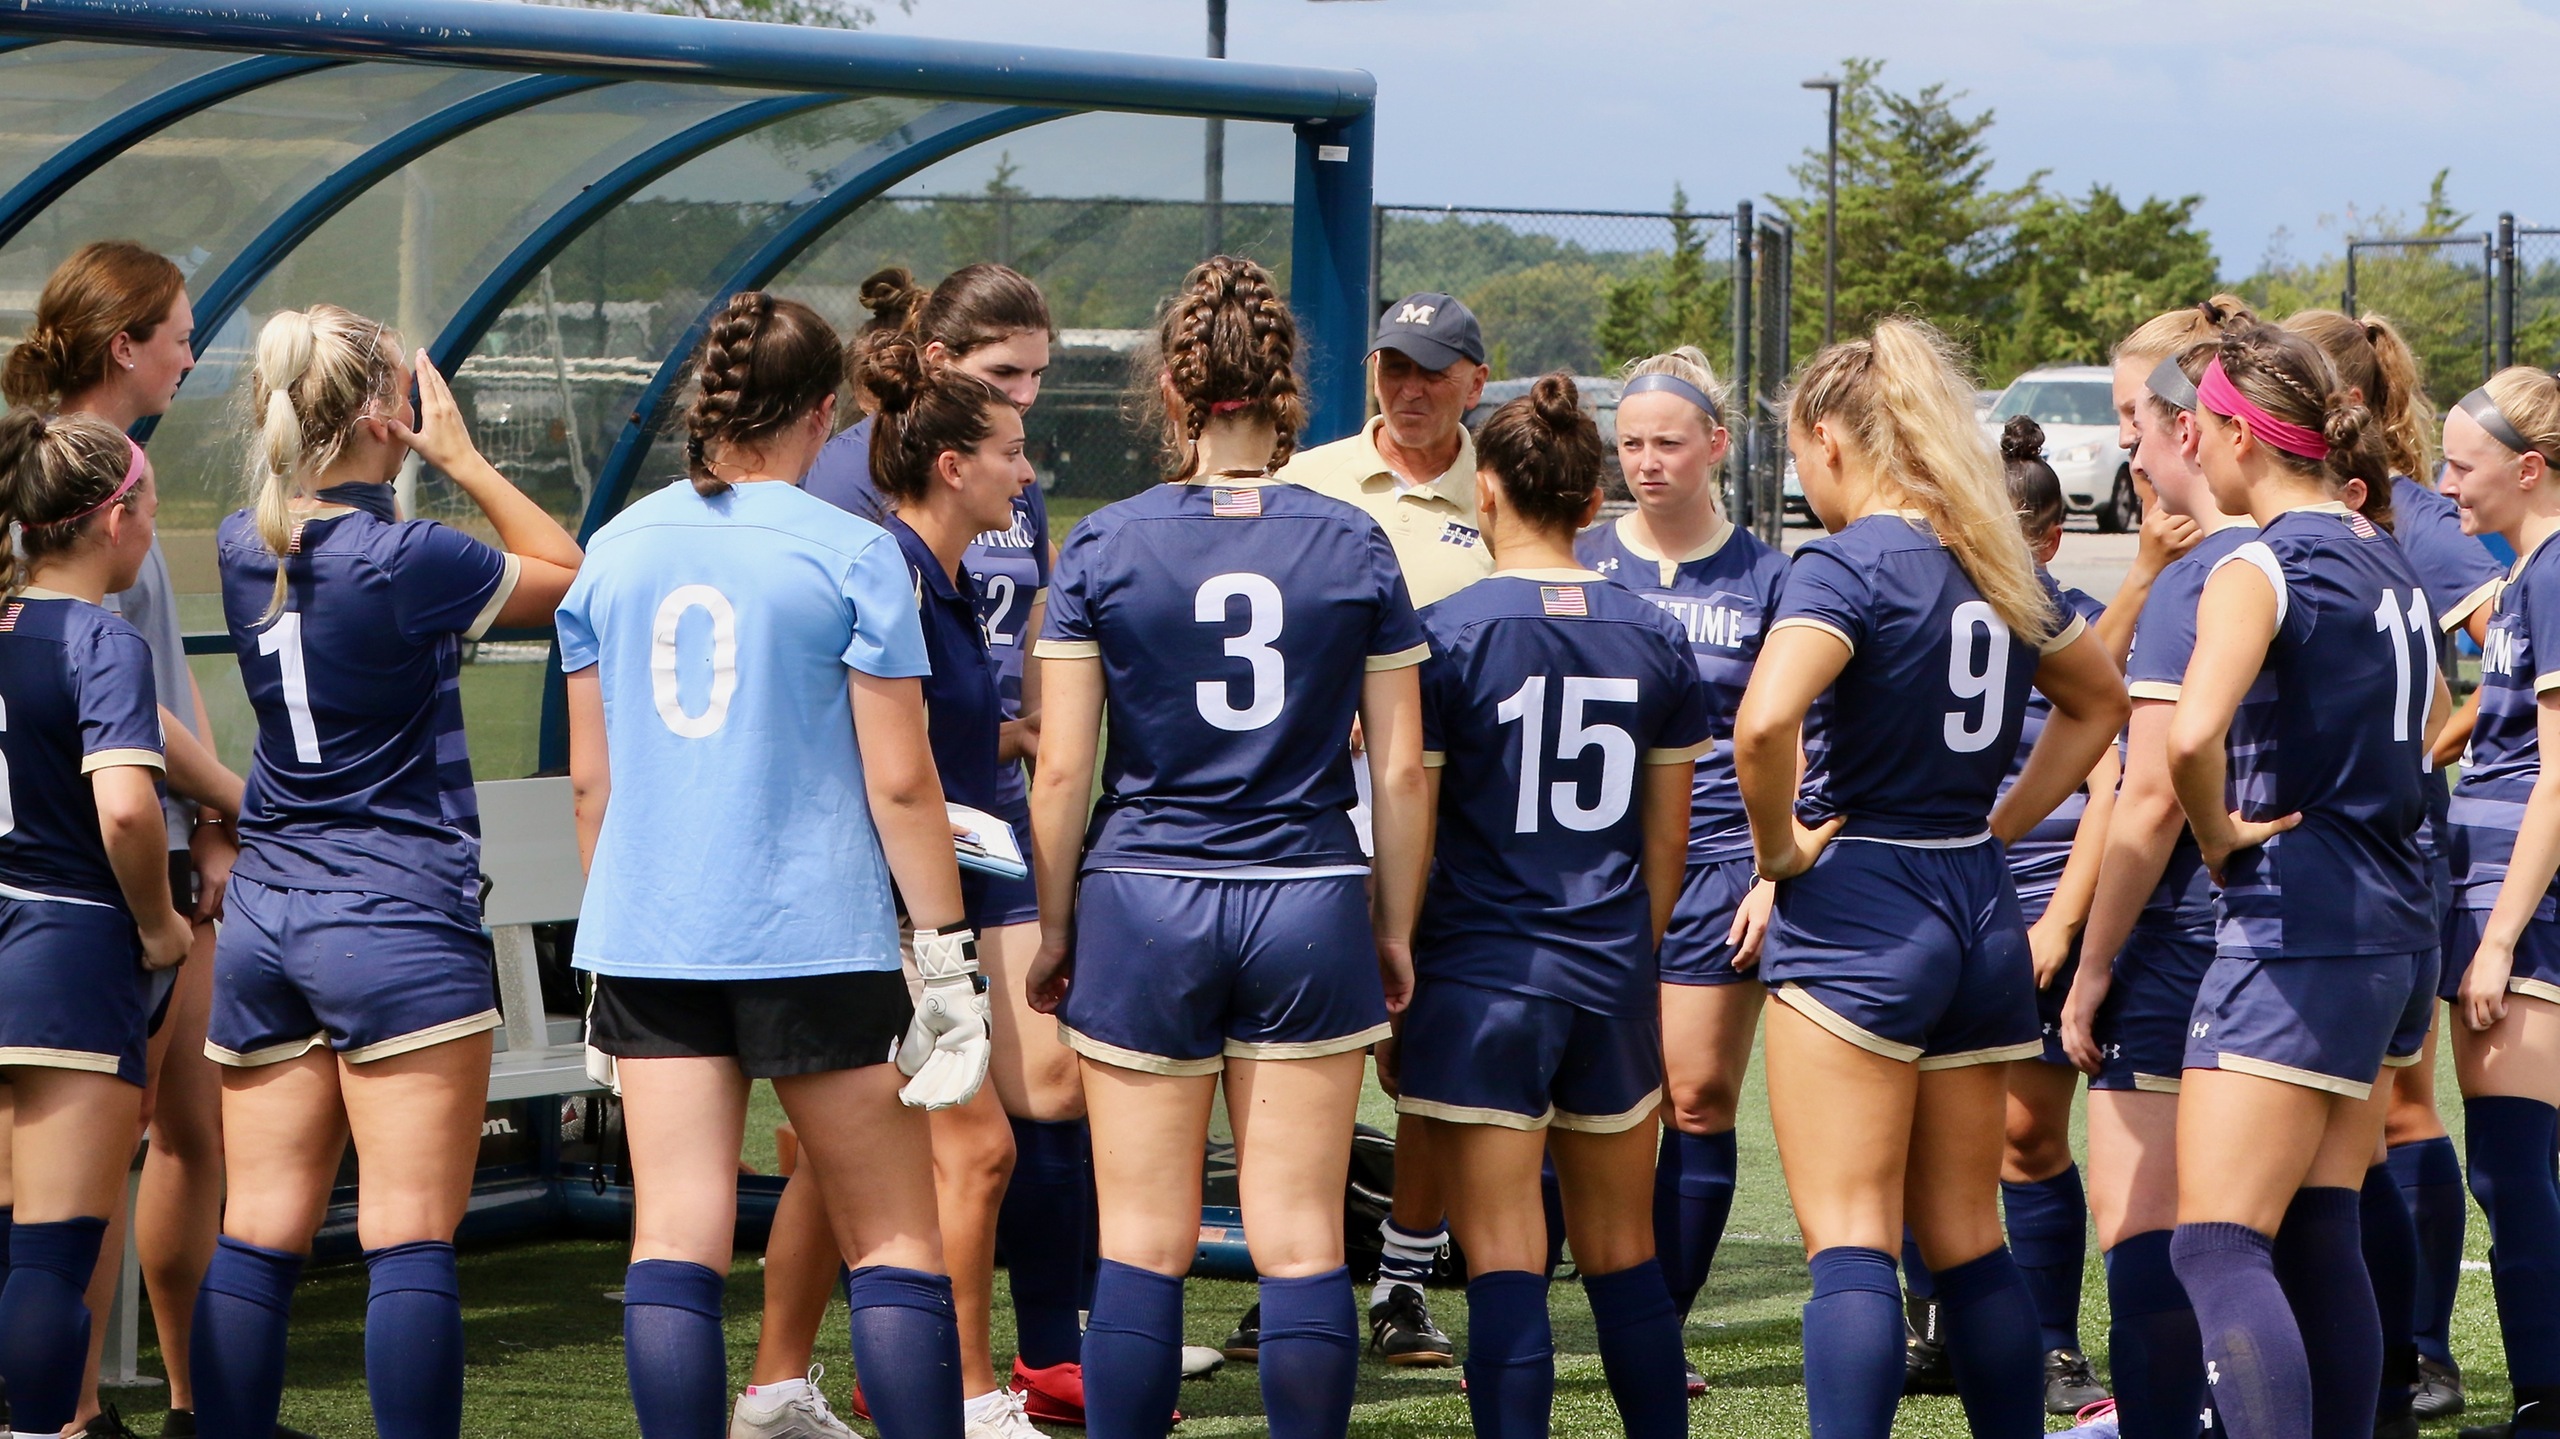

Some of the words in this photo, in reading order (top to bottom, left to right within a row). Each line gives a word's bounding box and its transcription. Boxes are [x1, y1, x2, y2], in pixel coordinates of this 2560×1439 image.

[1395, 303, 1435, 326] M
[652, 584, 737, 739] 0
[971, 573, 1015, 646] 2
[1194, 572, 1285, 731] 3
[1943, 600, 2011, 753] 9
[2373, 587, 2440, 742] 11
[257, 611, 322, 764] 1
[1497, 675, 1639, 834] 15
